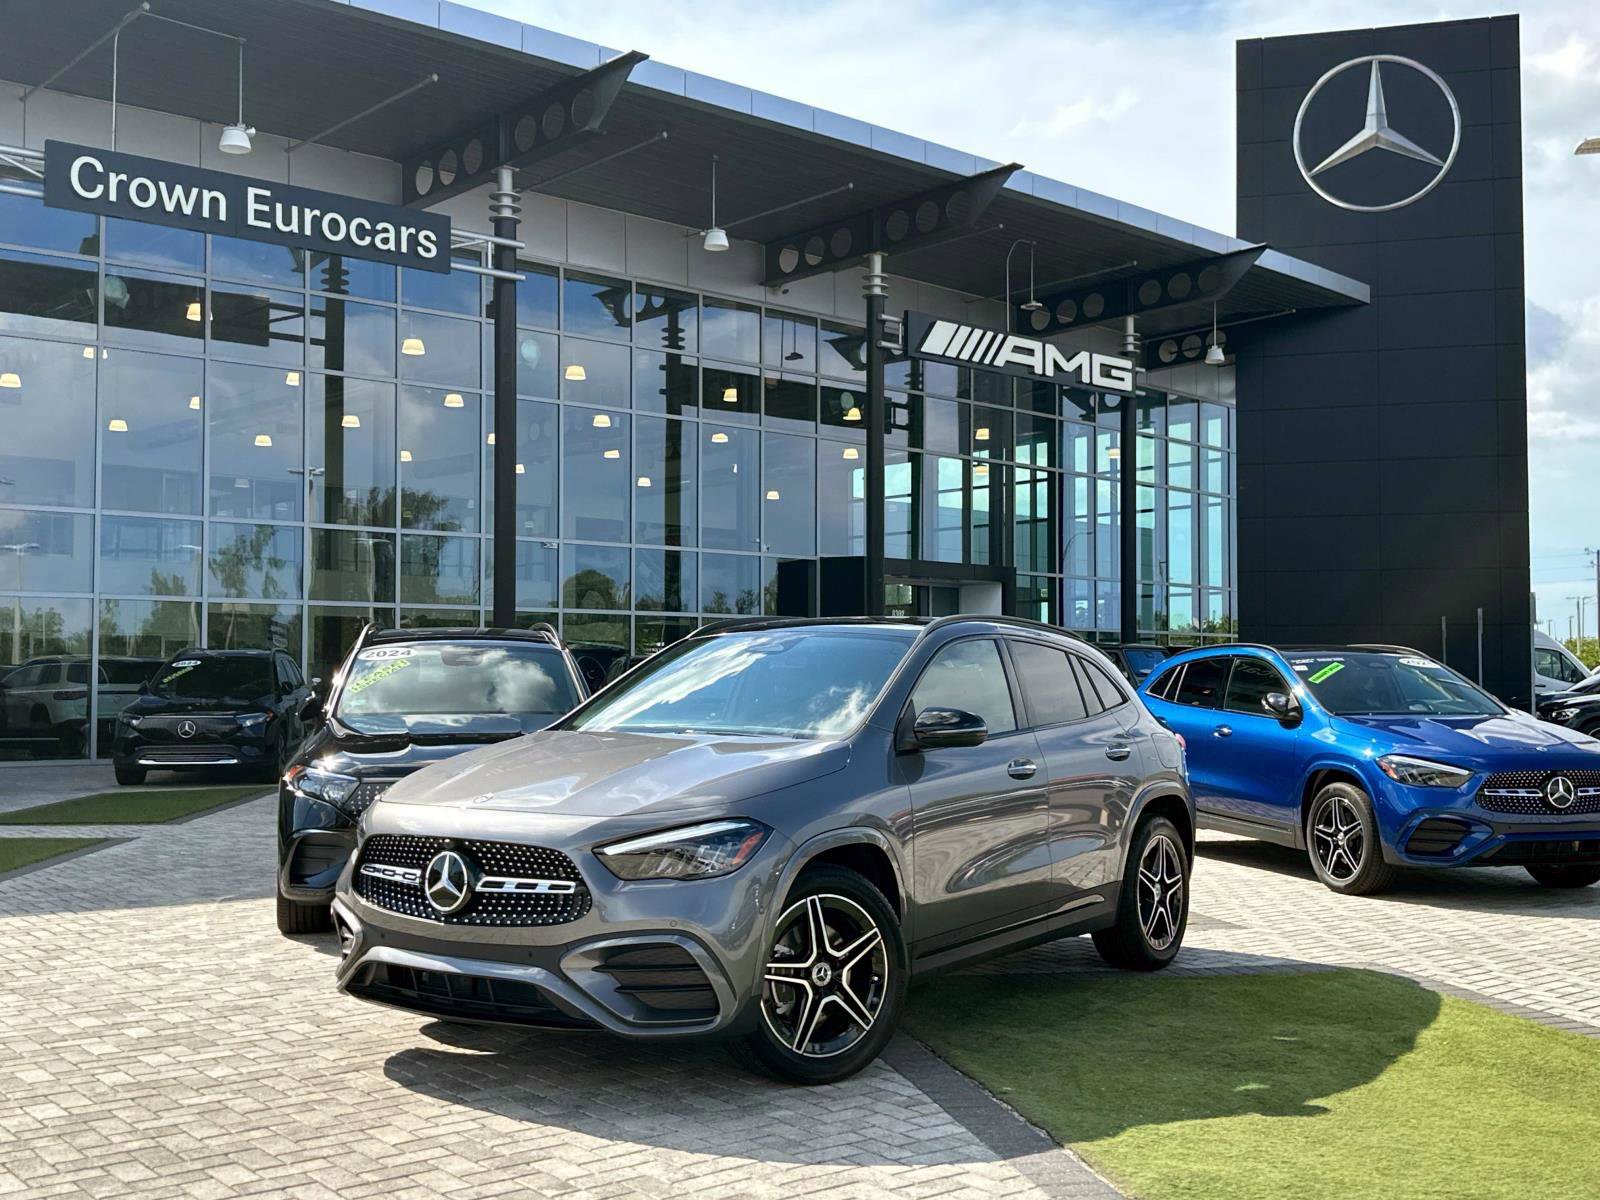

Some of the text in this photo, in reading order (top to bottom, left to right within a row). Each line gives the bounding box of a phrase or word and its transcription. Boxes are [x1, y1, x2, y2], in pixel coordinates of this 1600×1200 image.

[69, 155, 438, 260] Crown Eurocars
[992, 335, 1133, 392] AMG
[365, 649, 411, 658] 2024
